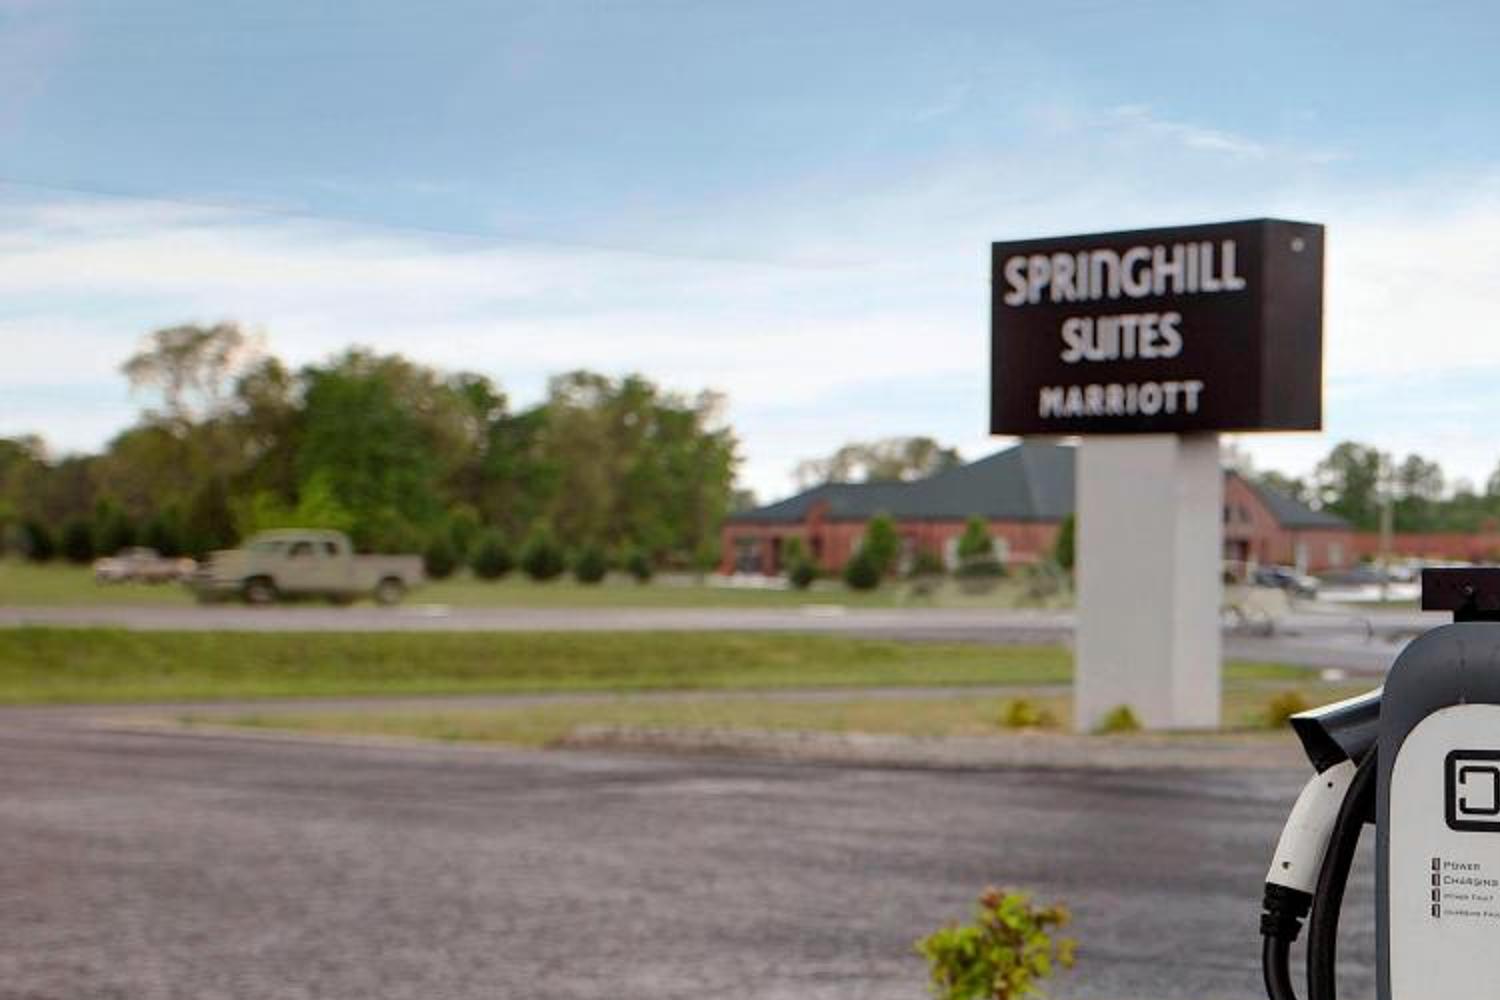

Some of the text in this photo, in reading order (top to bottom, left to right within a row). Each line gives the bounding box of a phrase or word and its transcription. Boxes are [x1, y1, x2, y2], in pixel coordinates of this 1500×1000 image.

[1003, 240, 1247, 306] SPRINGHILL
[1060, 312, 1184, 363] SUITES
[1038, 379, 1205, 419] MARRIOTT
